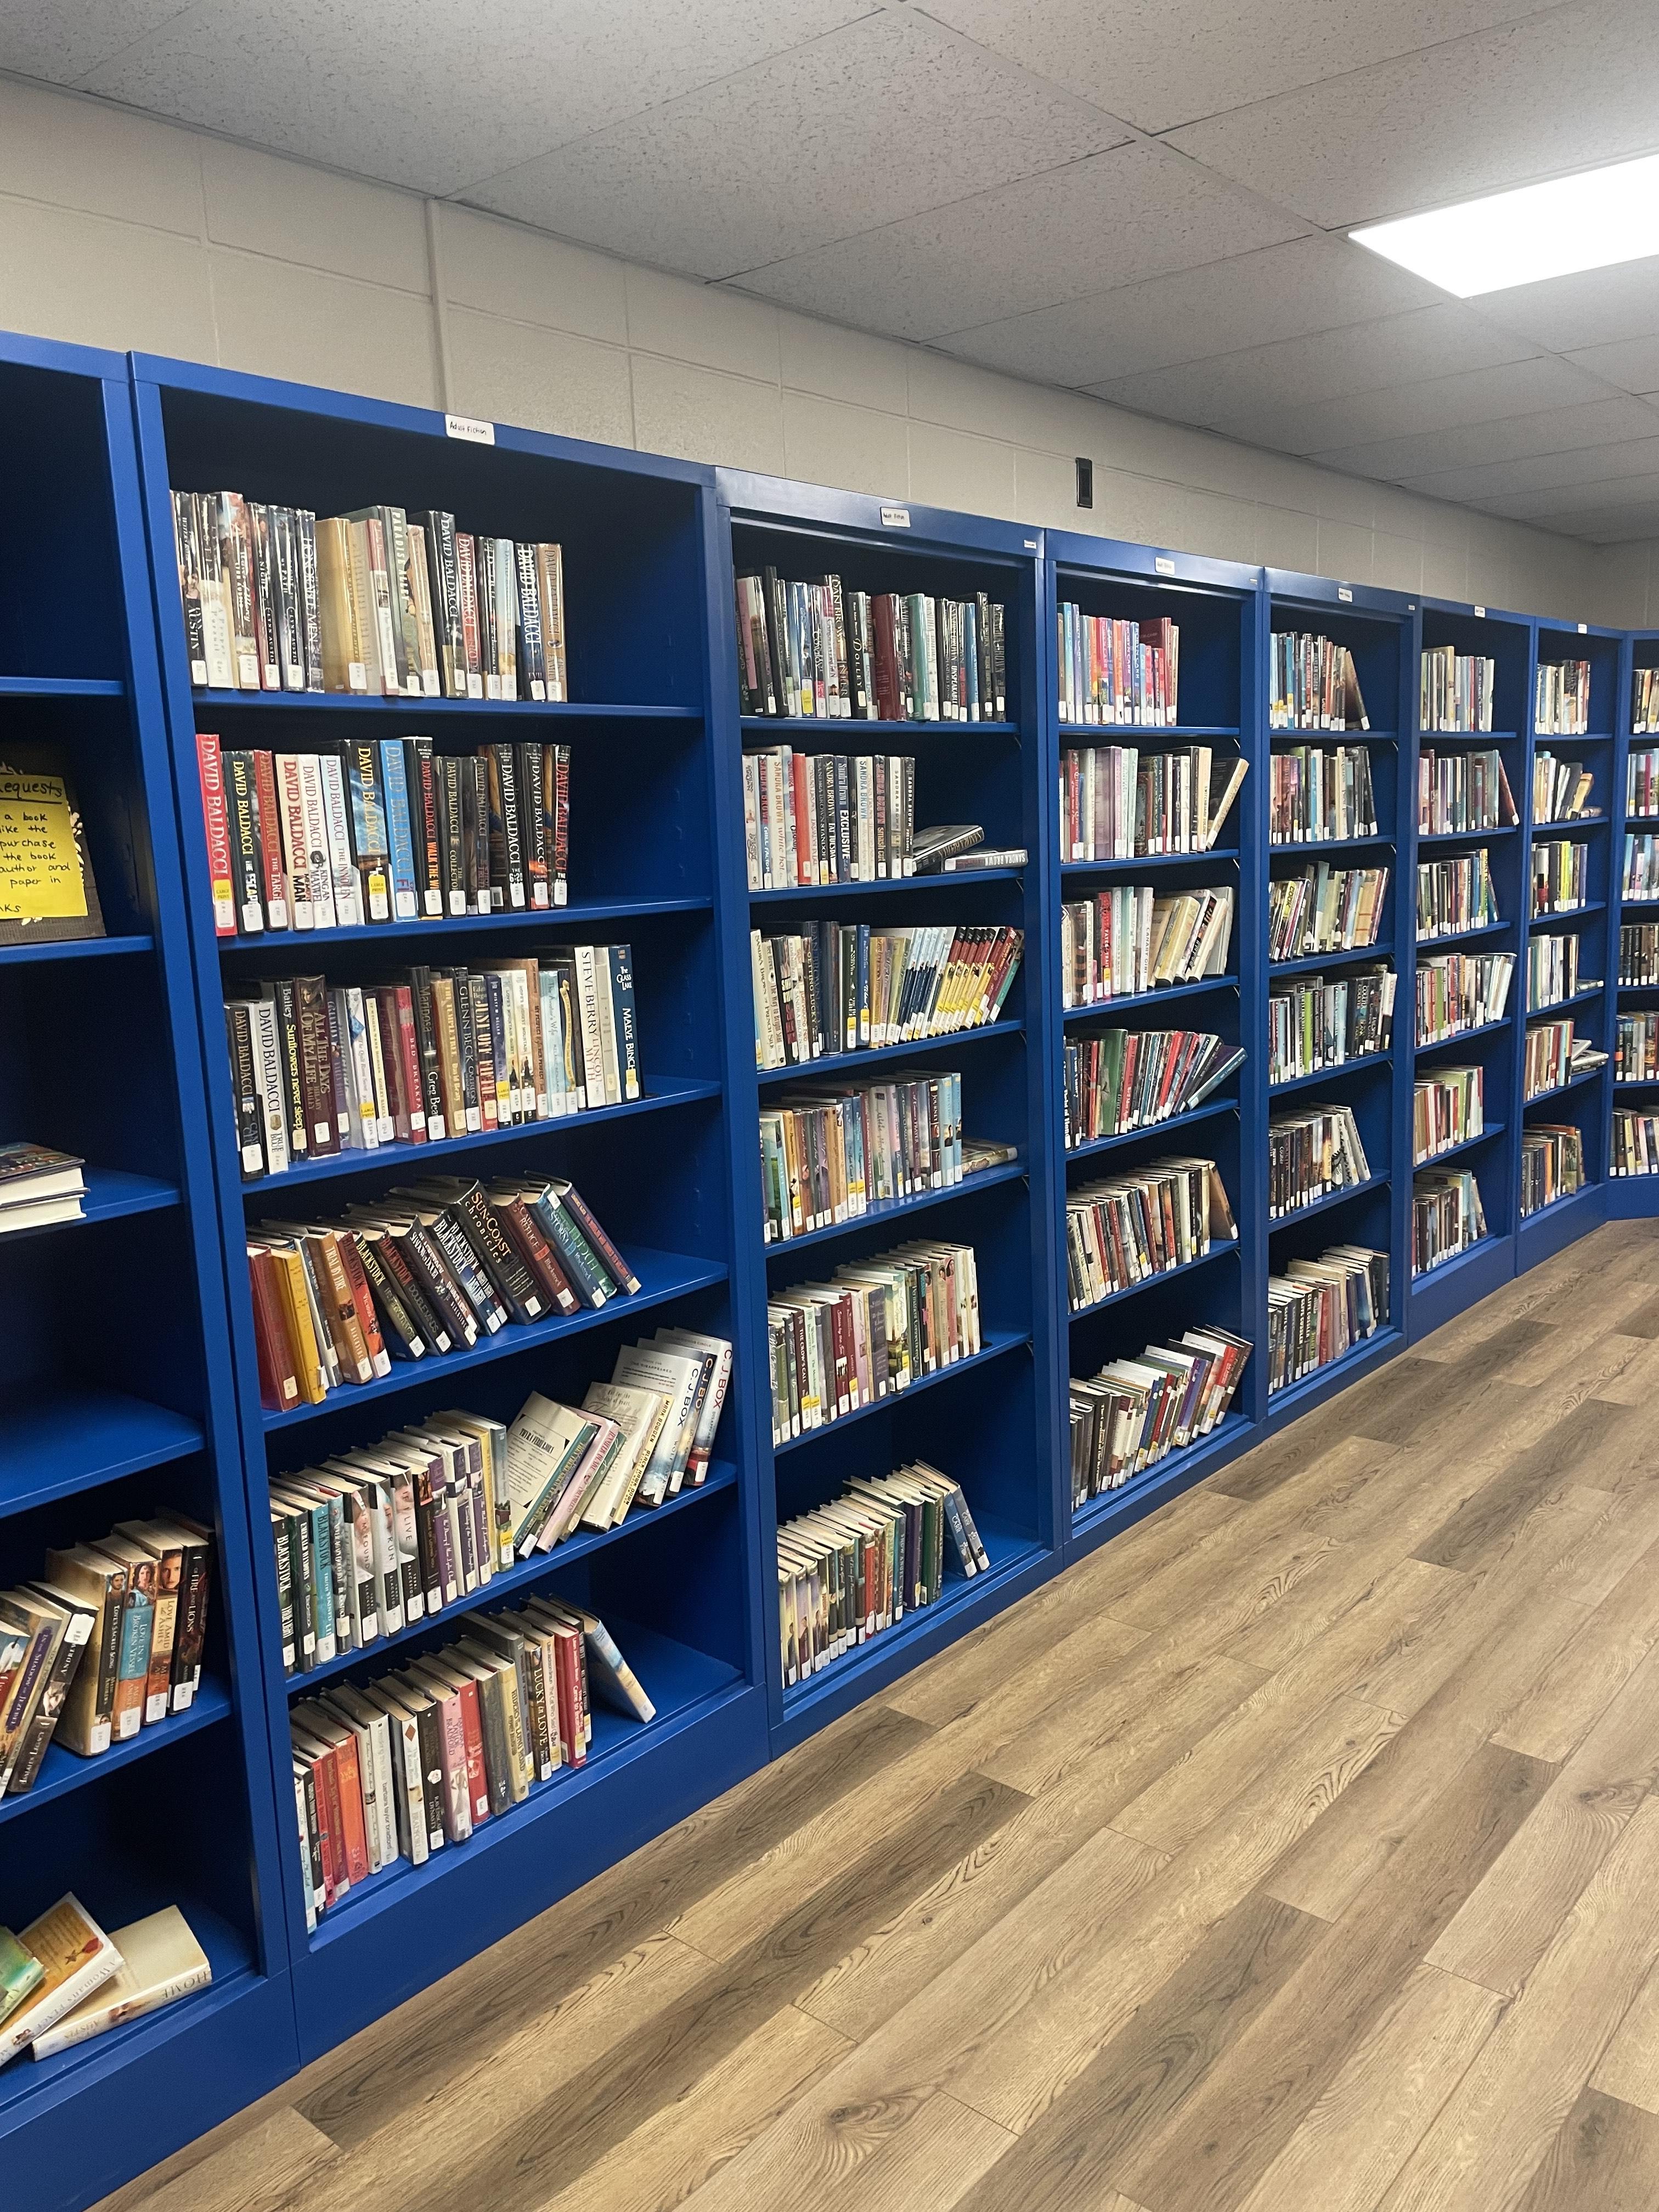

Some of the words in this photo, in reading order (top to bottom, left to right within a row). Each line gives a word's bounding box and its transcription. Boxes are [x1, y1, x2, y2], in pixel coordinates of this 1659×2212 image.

[392, 512, 405, 560] PARADISE
[441, 520, 452, 557] DAVID
[459, 538, 471, 574] DAVID
[445, 558, 458, 618] BALDACCI
[832, 579, 841, 602] DAN
[201, 741, 220, 791] DAVID
[233, 761, 247, 796] DAVID
[259, 755, 271, 789] DAVID
[284, 761, 299, 802] DAVID
[303, 766, 317, 796] DAVID
[326, 760, 339, 796] DAVID
[358, 747, 374, 787] DAVID
[386, 746, 403, 795] DAVID
[421, 761, 432, 789] DAVID
[447, 762, 457, 788] DAVID
[476, 764, 485, 789] DAVID
[501, 764, 515, 802] DAVID
[774, 762, 783, 792] SANDRA
[825, 761, 833, 788] SANDRA
[860, 761, 868, 788] SANDRA
[0, 783, 63, 798] equests
[532, 765, 542, 804] DAVID
[556, 764, 568, 803] DAVID
[23, 812, 48, 821] book
[330, 798, 345, 841] BALDACCI
[423, 792, 436, 839] BALDACCI
[447, 791, 459, 834] BALDACCI
[477, 791, 487, 837] BALDACCI
[827, 790, 835, 817] BROWN
[207, 796, 228, 874] BALDACCI
[237, 800, 253, 855] BALDACCI
[263, 794, 278, 852] BALDACCI
[289, 805, 306, 868] BALDACCI
[307, 800, 322, 853] BALDACCI
[363, 792, 380, 854] BALDACCI
[391, 799, 411, 872] BALDACCI
[505, 804, 520, 864] BALDACCI
[534, 806, 545, 868] BALDACCI
[555, 804, 568, 871] BALDACCI
[840, 810, 850, 859] EXCLUSIVE
[0, 839, 57, 850] purchase
[427, 842, 438, 860] WALK
[0, 864, 37, 872] author
[48, 862, 71, 871] and
[10, 879, 41, 889] paper
[428, 861, 438, 874] THE
[293, 876, 304, 902] MAN
[582, 952, 594, 992] STEVE
[283, 988, 292, 1018] Bailey
[419, 986, 432, 1032] Mariposa
[459, 986, 470, 1030] GLENN
[585, 995, 597, 1040] BERRY
[235, 1011, 246, 1042] DAVID
[259, 1009, 274, 1048] DAVID
[301, 1014, 314, 1032] OF
[314, 1013, 326, 1036] ALL
[622, 1007, 634, 1040] MAEVE
[303, 1032, 315, 1053] MY
[317, 1037, 328, 1062] THE
[464, 1031, 475, 1064] BECK
[238, 1045, 253, 1095] BALDACCI
[263, 1049, 280, 1113] BALDACCI
[286, 1024, 296, 1076] Sunflowers
[294, 1102, 303, 1130] sleep
[304, 1054, 317, 1084] LIFE
[319, 1064, 330, 1094] DAYS
[585, 1047, 596, 1081] MYTH
[428, 1071, 438, 1096] Greg
[270, 1133, 280, 1153] BLUE
[433, 1218, 468, 1274] BLACKSTOCK
[449, 1222, 480, 1271] BLACKSTOCK
[465, 1201, 503, 1264] chronicles
[325, 1245, 340, 1269] TRIAL
[333, 1274, 347, 1291] FIRE
[342, 1237, 367, 1289] BLACKSTOCK
[356, 1239, 386, 1286] BLACKSTOCK
[379, 1235, 414, 1287] BLACKSTOCK
[660, 1400, 670, 1418] MARK
[714, 1378, 726, 1409] BOX
[678, 1397, 692, 1427] BOX
[650, 1418, 663, 1443] BOWDEN
[641, 1450, 651, 1469] BLACK
[632, 1468, 644, 1487] HAWK
[403, 1491, 409, 1501] IF
[625, 1486, 636, 1505] DOWN
[317, 1514, 330, 1571] BLACKSTOCK
[404, 1516, 413, 1541] LIVE
[277, 1534, 291, 1593] BLACKSTOCK
[190, 1574, 200, 1593] FIRE
[167, 1600, 176, 1622] LOVE
[187, 1605, 197, 1633] LIONS
[132, 1615, 142, 1646] BROKEN
[138, 1623, 148, 1641] LOVE
[157, 1617, 166, 1645] ASHES
[164, 1626, 173, 1649] AMID
[128, 1647, 137, 1674] VESSEL
[534, 1668, 545, 1707] LUCKY
[538, 1715, 549, 1745] LOVE
